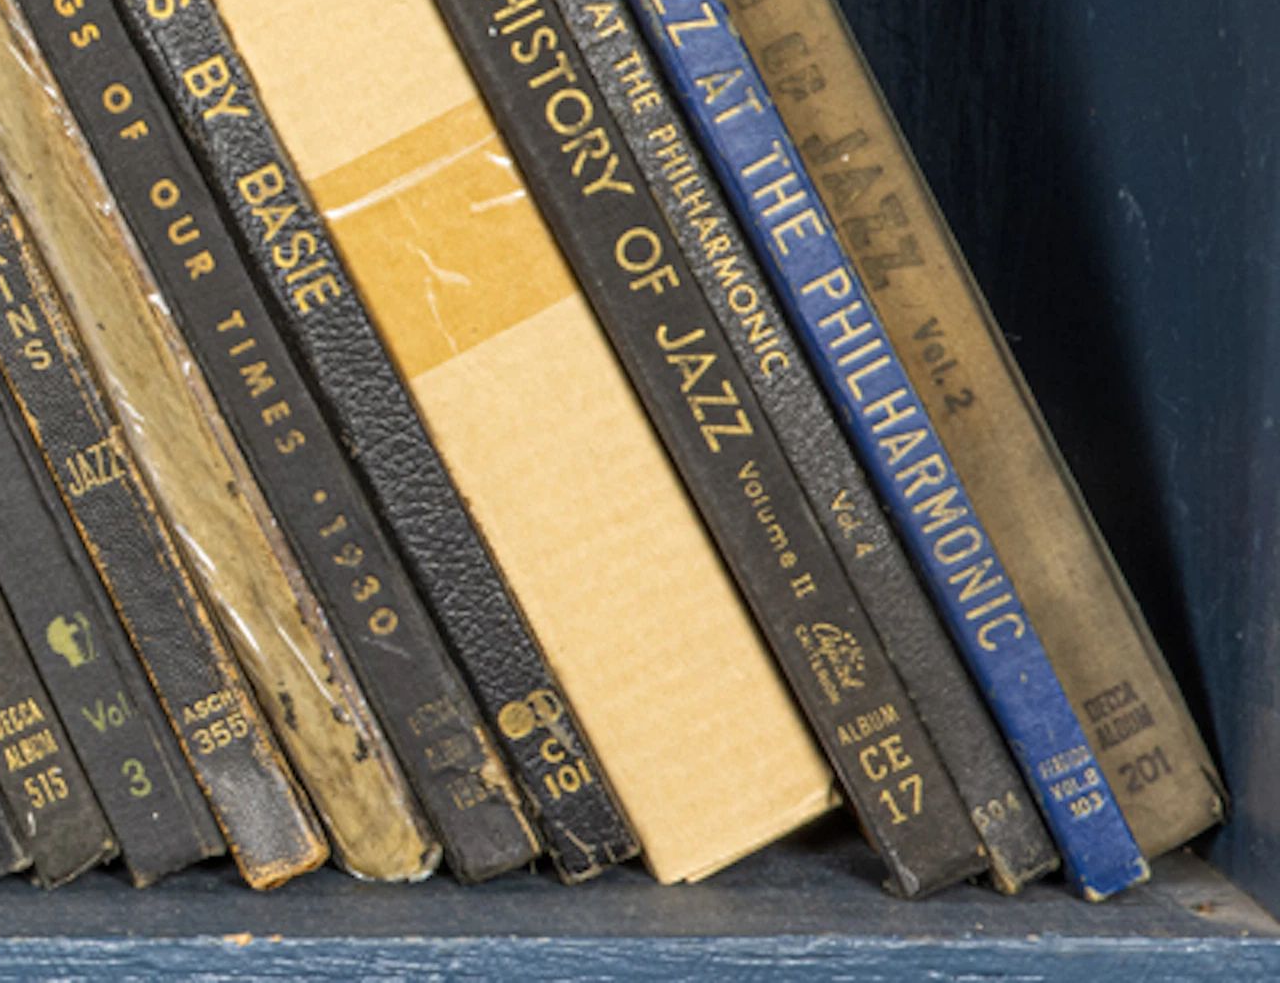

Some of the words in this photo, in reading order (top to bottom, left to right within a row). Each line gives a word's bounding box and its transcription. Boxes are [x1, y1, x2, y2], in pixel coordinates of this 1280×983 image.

[181, 54, 249, 120] BY
[237, 163, 340, 313] BASIE
[102, 83, 148, 139] OF
[150, 179, 214, 279] OUR
[216, 310, 305, 453] TIMES
[583, 3, 627, 38] AT
[614, 49, 661, 114] THE
[647, 124, 789, 378] PHILHARMONIC
[830, 489, 861, 537] Vol.
[856, 543, 874, 558] 4
[804, 127, 925, 290] JAZZ
[910, 315, 957, 383] Vol.
[942, 385, 976, 417] 2
[694, 69, 762, 124] AT
[741, 140, 824, 255] THE
[800, 266, 1024, 650] PHILHARMONIC
[615, 227, 679, 293] OF
[655, 324, 753, 452] JAZZ
[737, 460, 797, 568] Volume
[66, 438, 125, 497] JAZZ
[82, 691, 138, 733] Vol.
[183, 690, 234, 725] ASCH
[837, 703, 899, 745] ALBUM
[3, 728, 58, 771] ALBUM
[191, 713, 249, 755] 355
[540, 739, 565, 765] C
[121, 759, 151, 797] 3
[543, 758, 592, 799] 101
[859, 734, 912, 781] CE
[1119, 746, 1172, 792] 201
[26, 767, 69, 808] 515
[879, 774, 922, 824] 17
